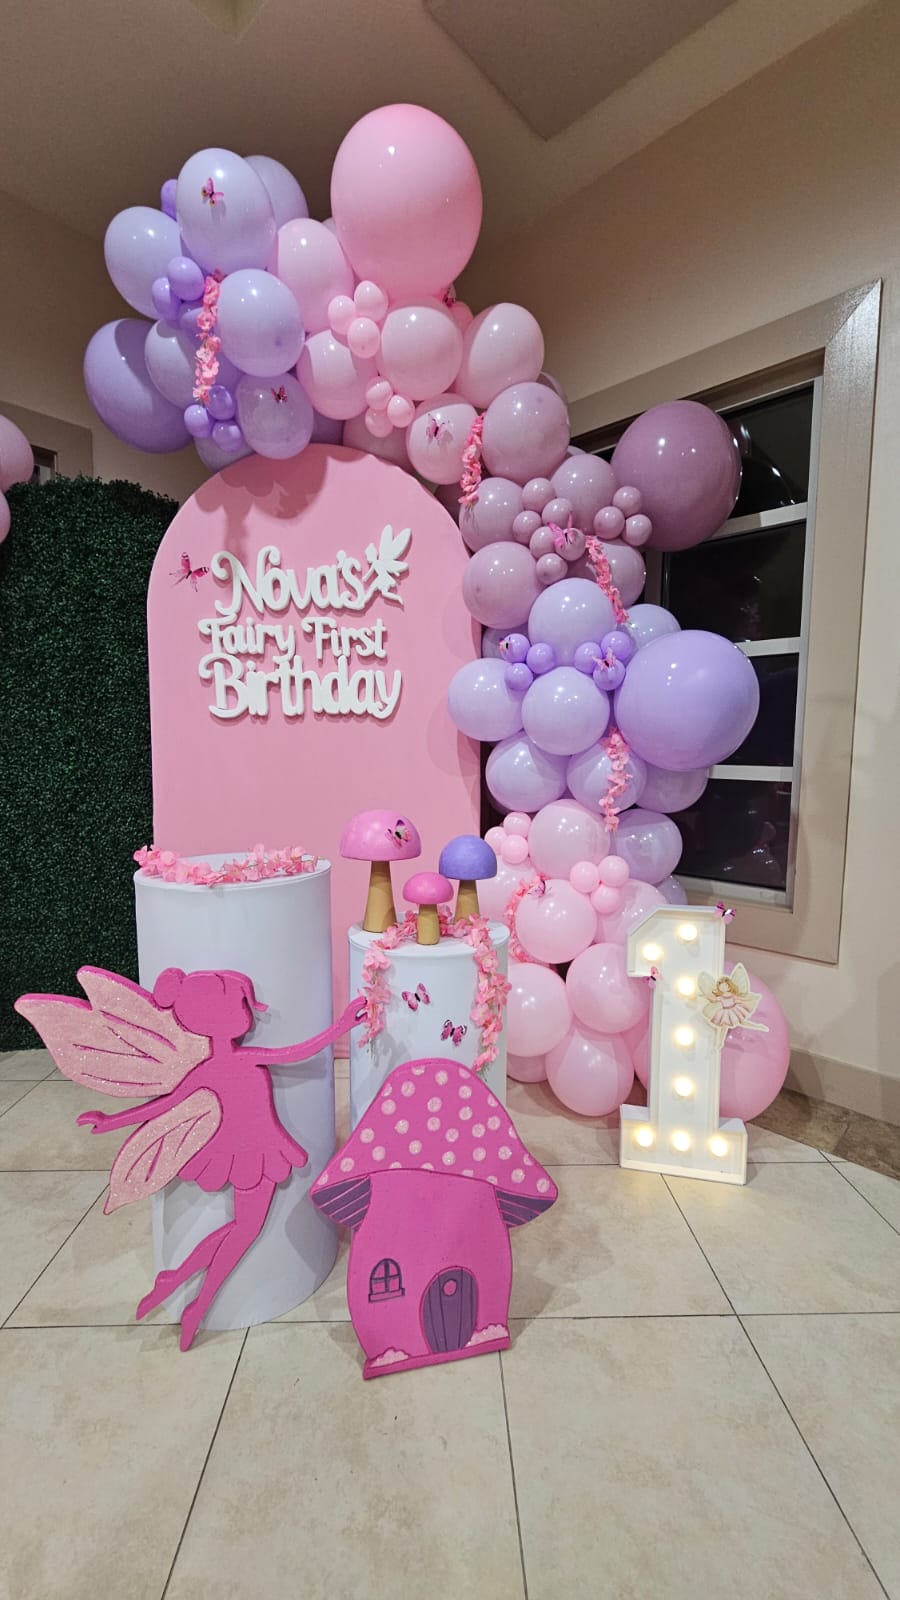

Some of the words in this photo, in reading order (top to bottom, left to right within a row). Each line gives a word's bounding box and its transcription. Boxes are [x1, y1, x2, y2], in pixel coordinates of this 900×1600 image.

[211, 545, 366, 615] Nova's
[198, 613, 295, 662] Fairy
[302, 617, 387, 659] First
[199, 653, 402, 719] Birthday
[620, 905, 748, 1185] 1
